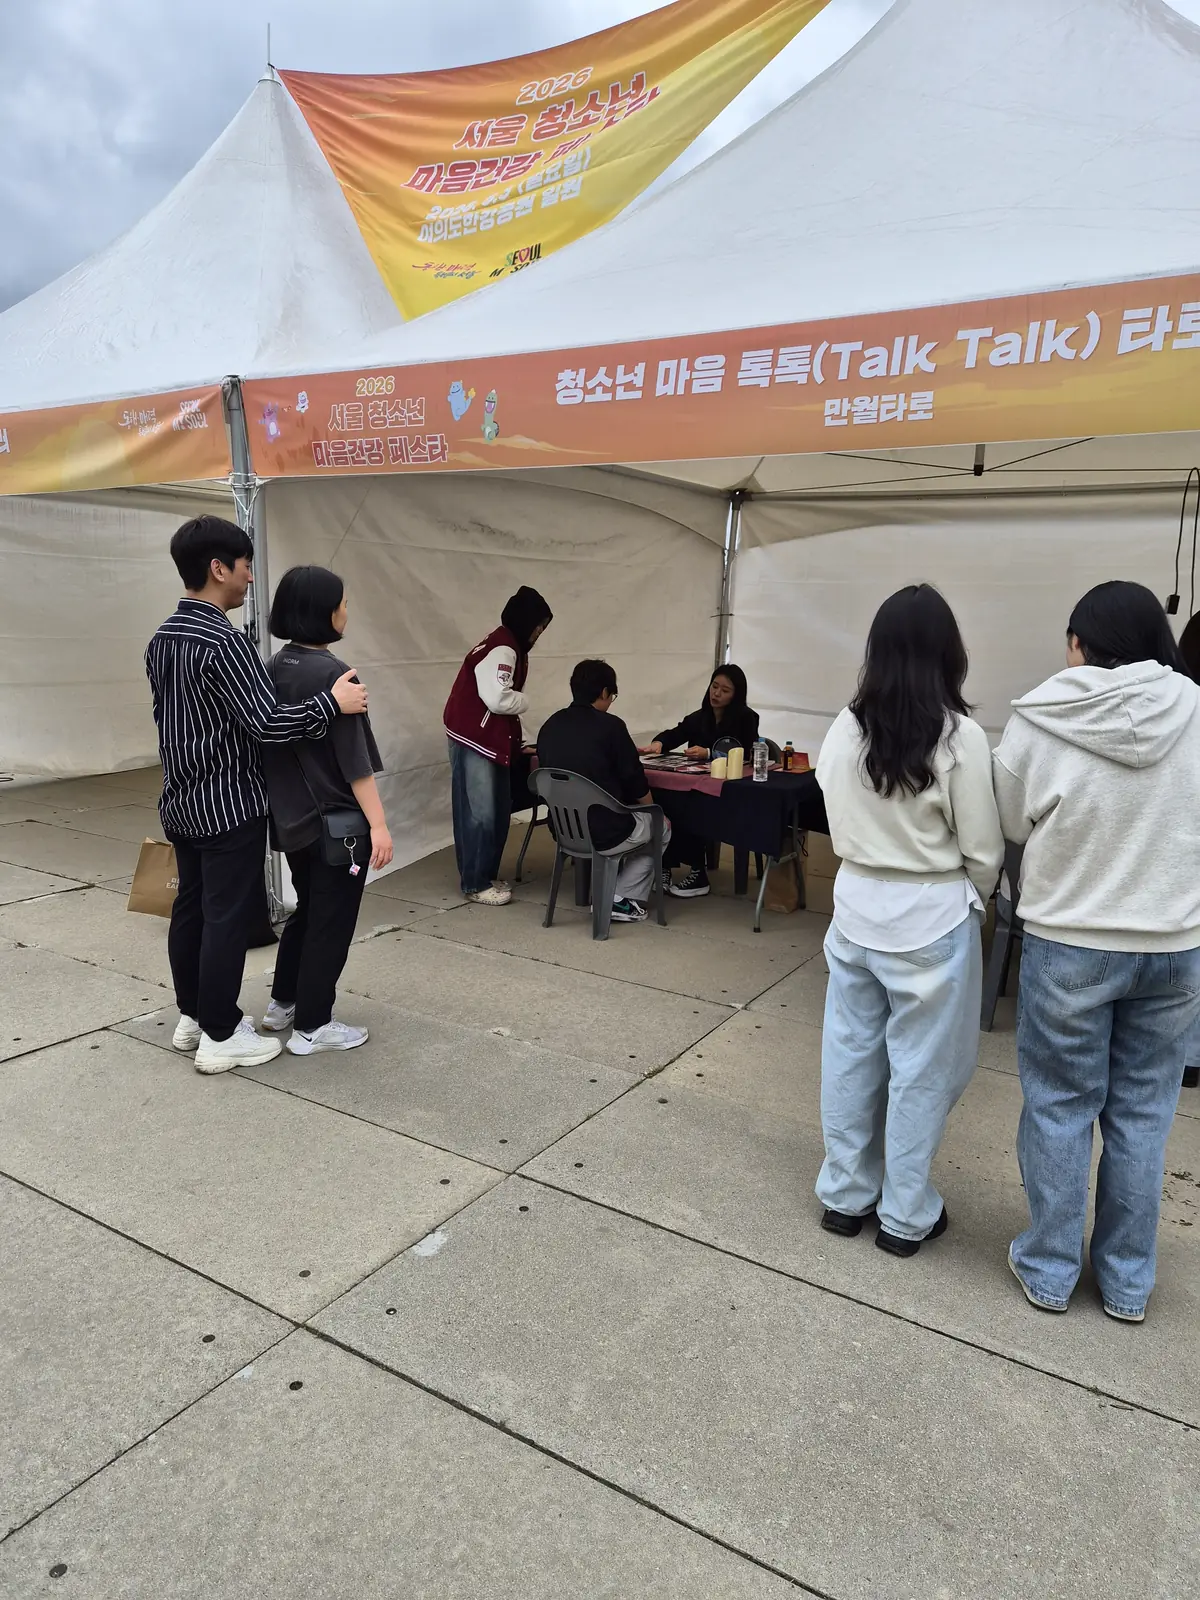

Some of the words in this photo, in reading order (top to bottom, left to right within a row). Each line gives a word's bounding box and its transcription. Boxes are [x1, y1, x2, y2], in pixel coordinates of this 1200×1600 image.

[516, 67, 593, 105] 2026
[453, 114, 527, 149] 서울
[531, 71, 646, 142] 청소년
[400, 149, 543, 194] 마음건강
[417, 193, 536, 243] 여의도한강공원
[541, 175, 583, 208] 일원
[504, 243, 542, 268] SEOUL
[555, 362, 646, 405] 청소년
[655, 354, 726, 397] 마음
[737, 334, 939, 387] 톡톡(Talk
[956, 310, 1101, 369] Talk)
[356, 376, 395, 396] 2026
[328, 402, 363, 431] 서울
[368, 397, 425, 430] 청소년
[824, 390, 935, 427] 만월타로
[312, 437, 384, 467] 마음건강
[387, 433, 448, 465] 페스타
